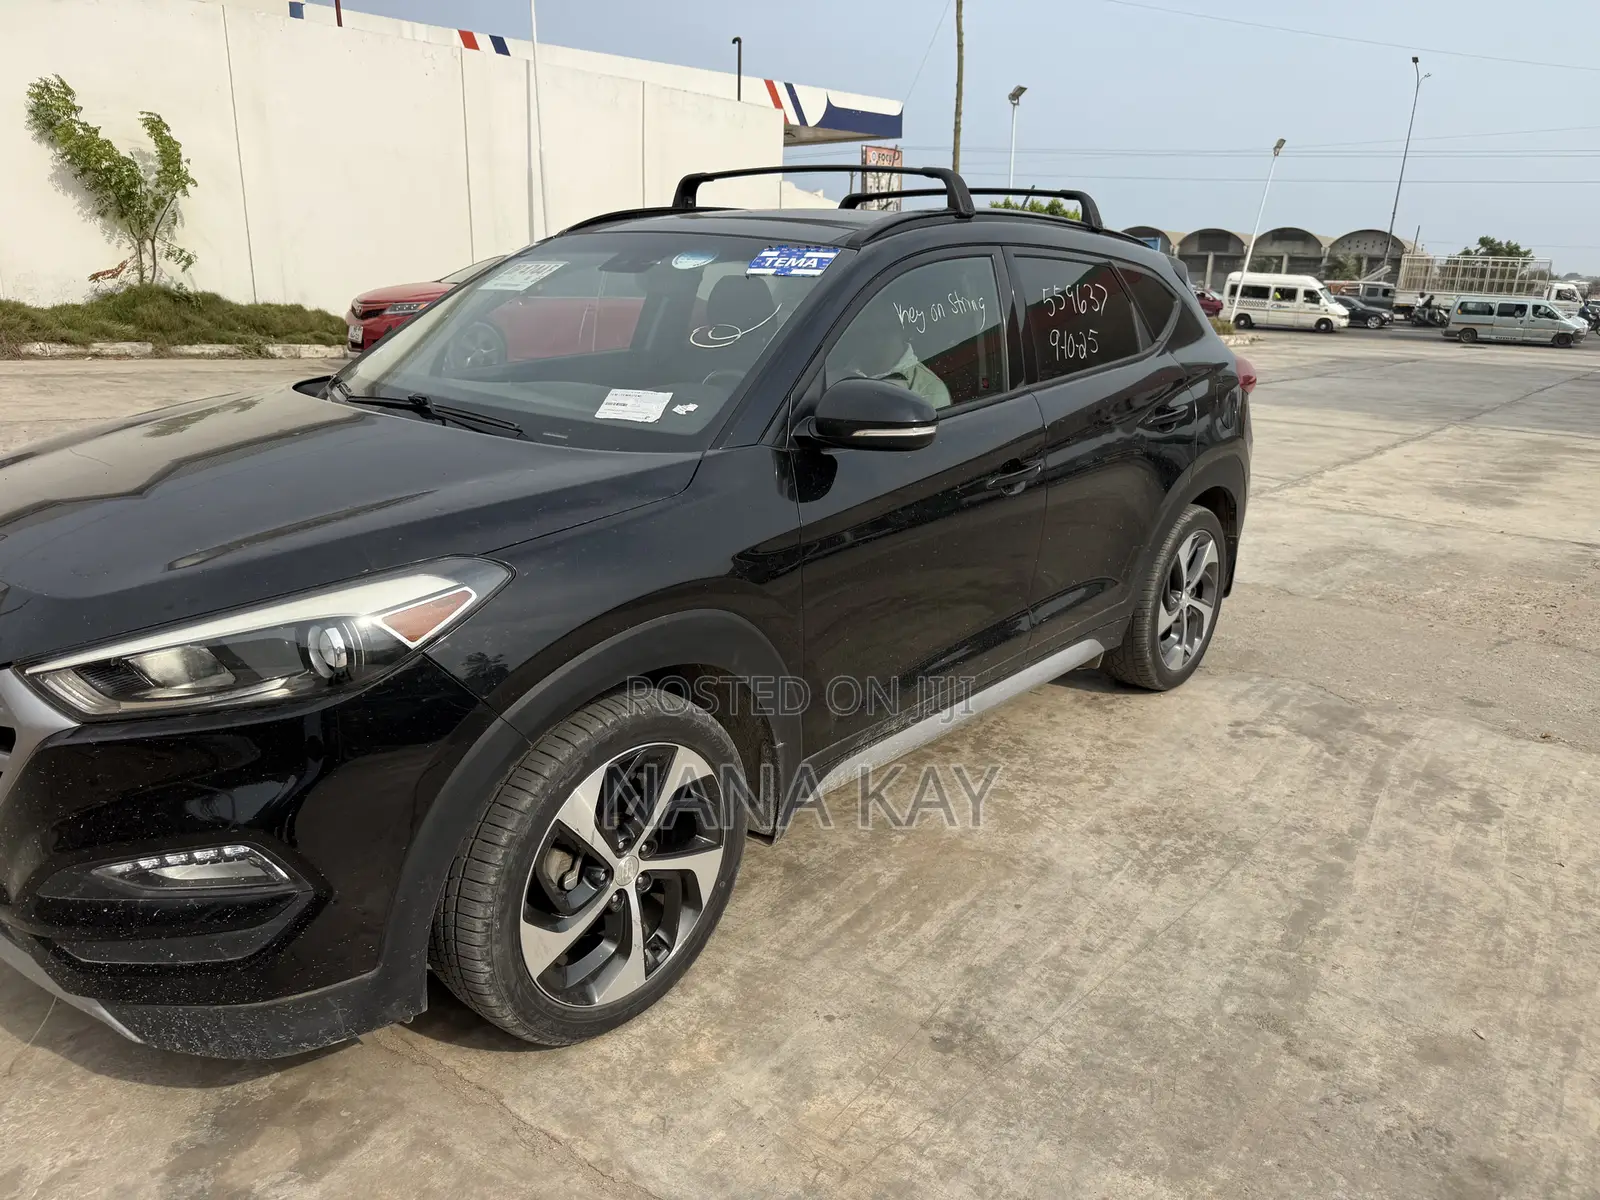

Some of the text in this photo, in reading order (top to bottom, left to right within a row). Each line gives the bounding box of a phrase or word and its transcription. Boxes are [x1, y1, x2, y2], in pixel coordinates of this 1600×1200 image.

[765, 257, 818, 268] TEMA
[1042, 283, 1108, 317] 559637
[930, 303, 946, 322] on
